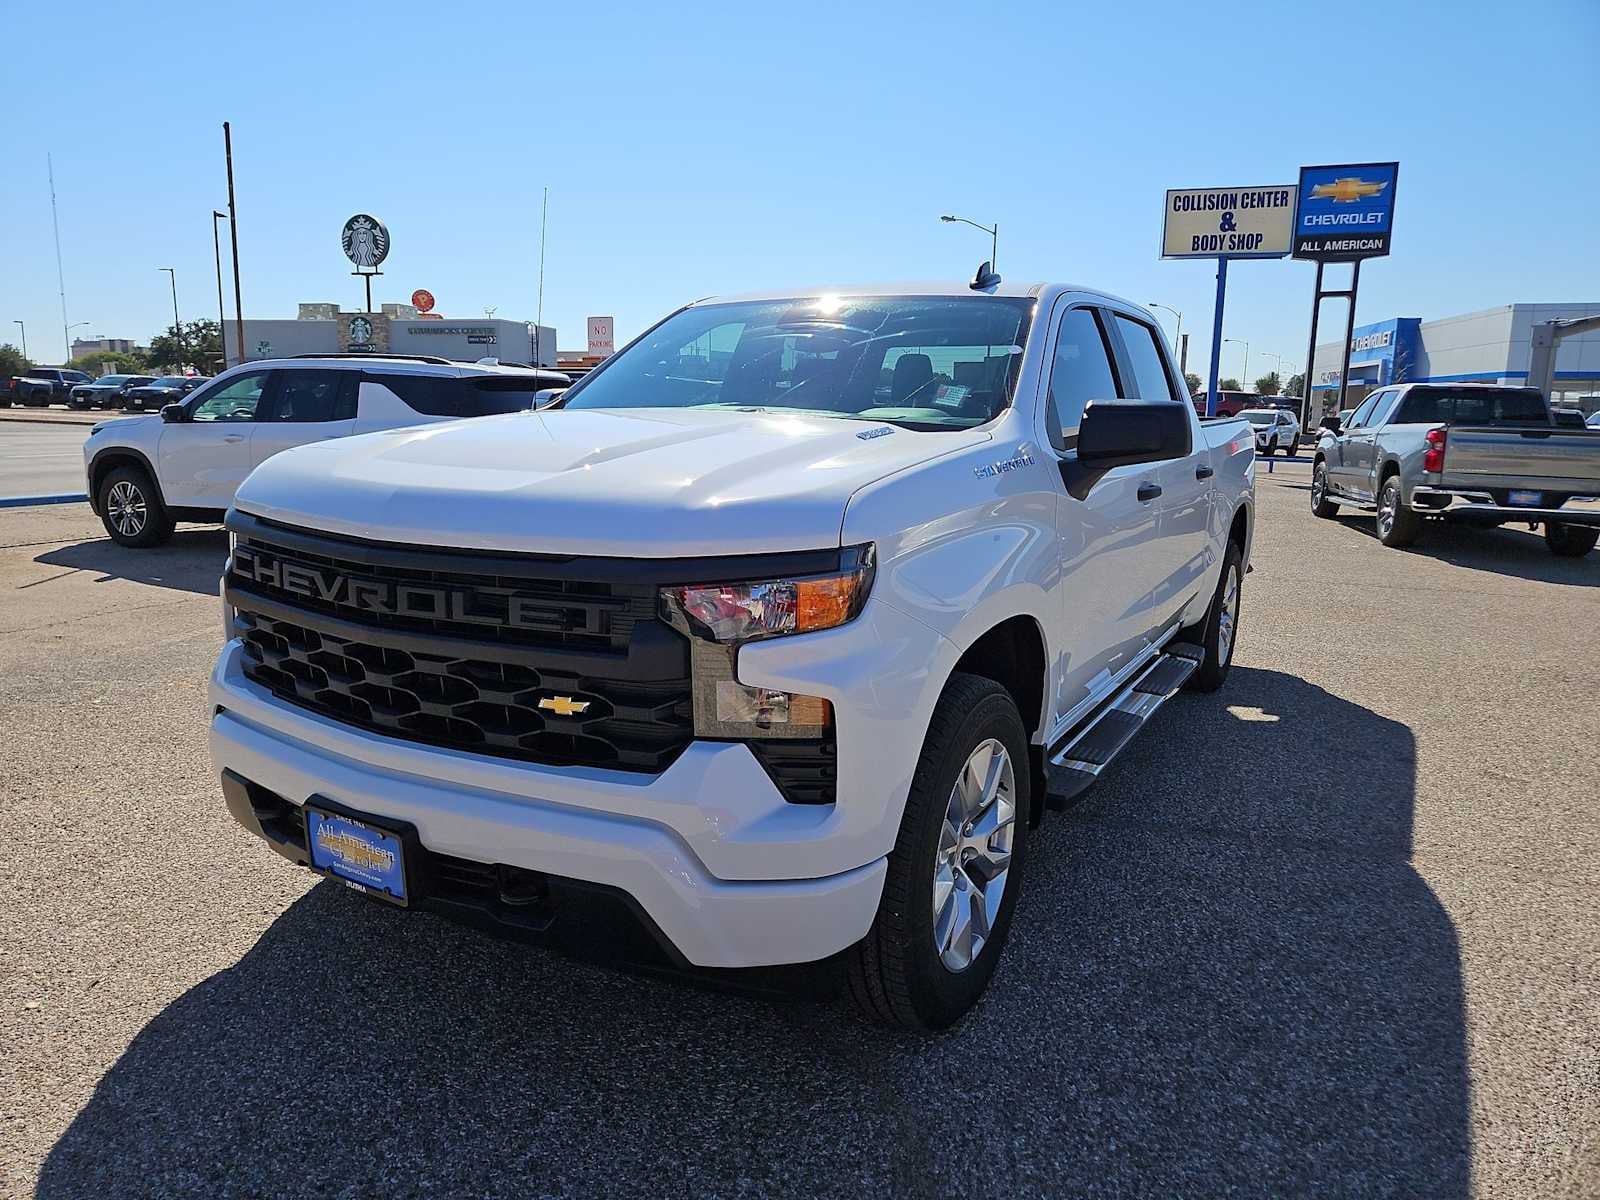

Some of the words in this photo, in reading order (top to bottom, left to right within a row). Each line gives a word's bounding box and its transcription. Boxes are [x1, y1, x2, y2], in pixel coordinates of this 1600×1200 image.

[1173, 193, 1238, 212] COLLISION
[1240, 190, 1289, 209] CENTER
[1219, 211, 1237, 232] &
[1303, 212, 1385, 226] CHEVROLET
[1191, 234, 1226, 252] BODY
[1228, 233, 1263, 251] SHOP
[1300, 241, 1321, 252] ALL
[1324, 239, 1384, 251] AMERICAN
[593, 326, 607, 335] NO
[588, 340, 612, 348] PARKING
[232, 549, 628, 636] CHEVROLET
[317, 823, 334, 840] All
[338, 829, 394, 862] American
